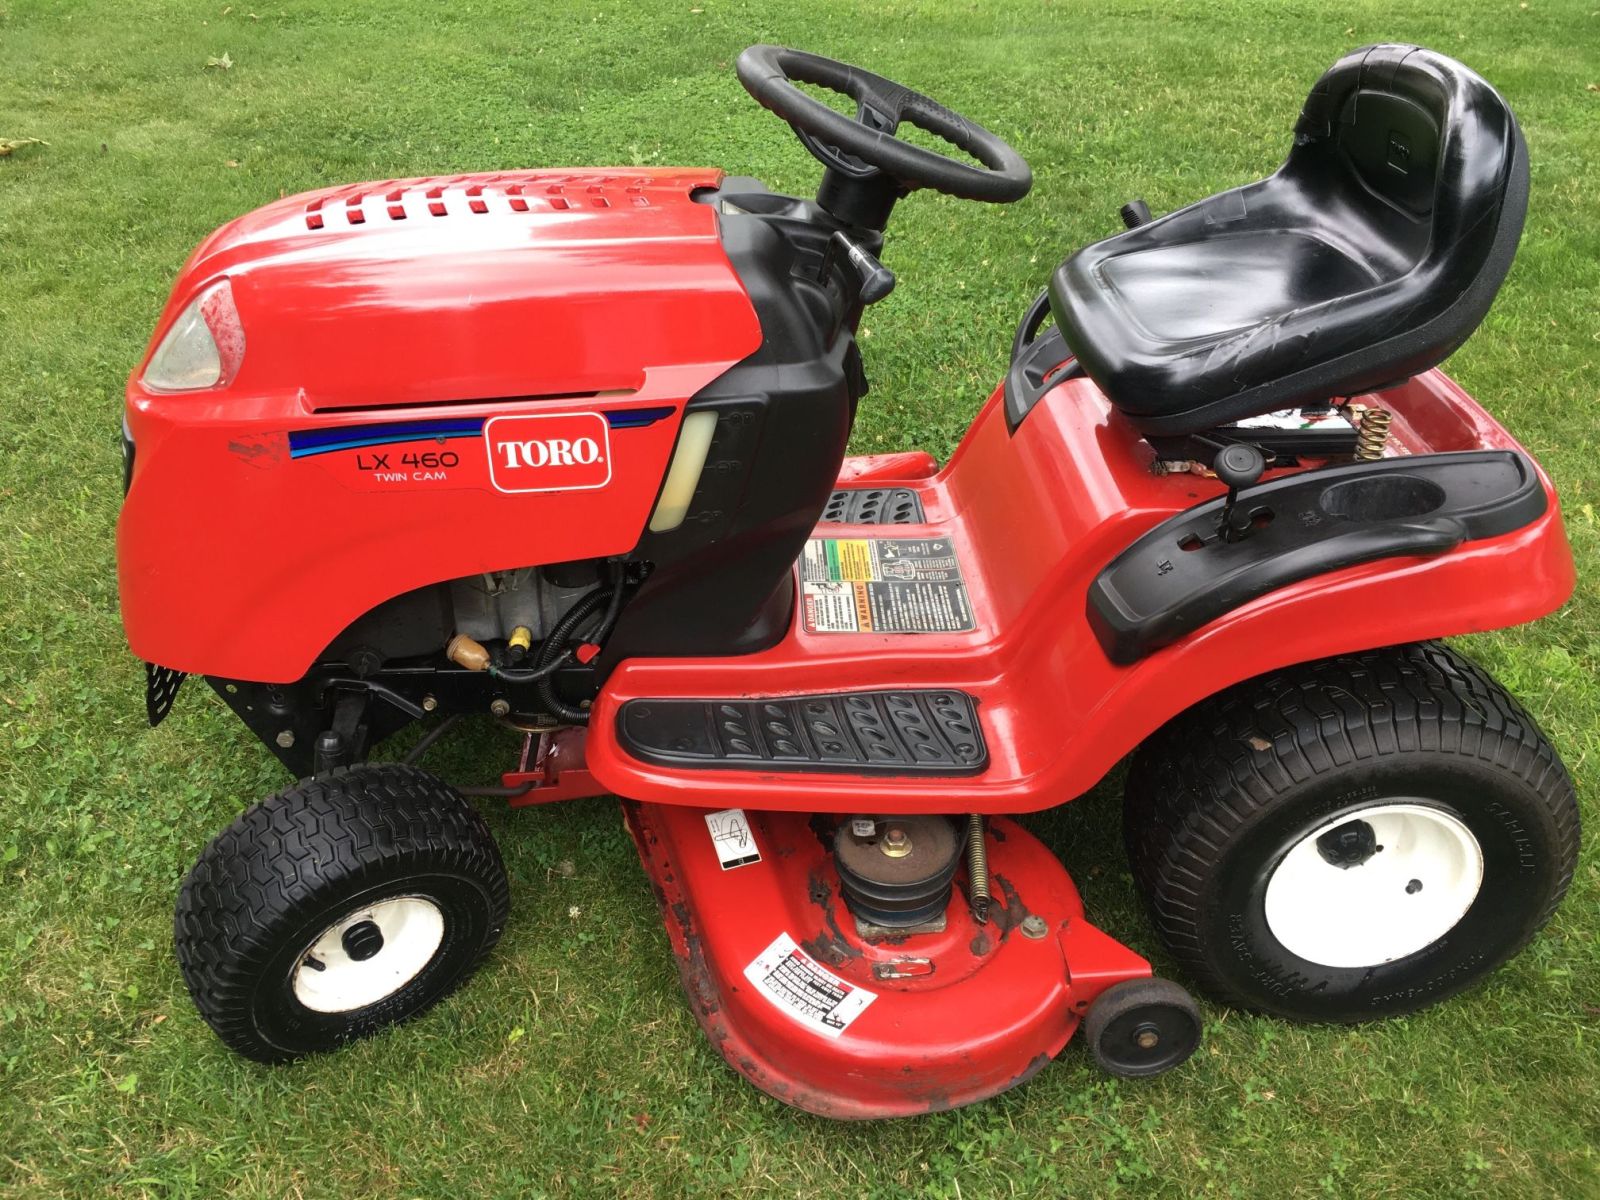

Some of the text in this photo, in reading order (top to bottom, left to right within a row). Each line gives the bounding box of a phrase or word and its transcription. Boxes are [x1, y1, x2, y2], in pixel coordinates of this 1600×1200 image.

[356, 451, 459, 470] LX 460
[497, 437, 599, 469] TORO
[373, 471, 447, 482] TWIN CAM
[806, 597, 815, 622] DANGER
[856, 585, 868, 620] WARNING
